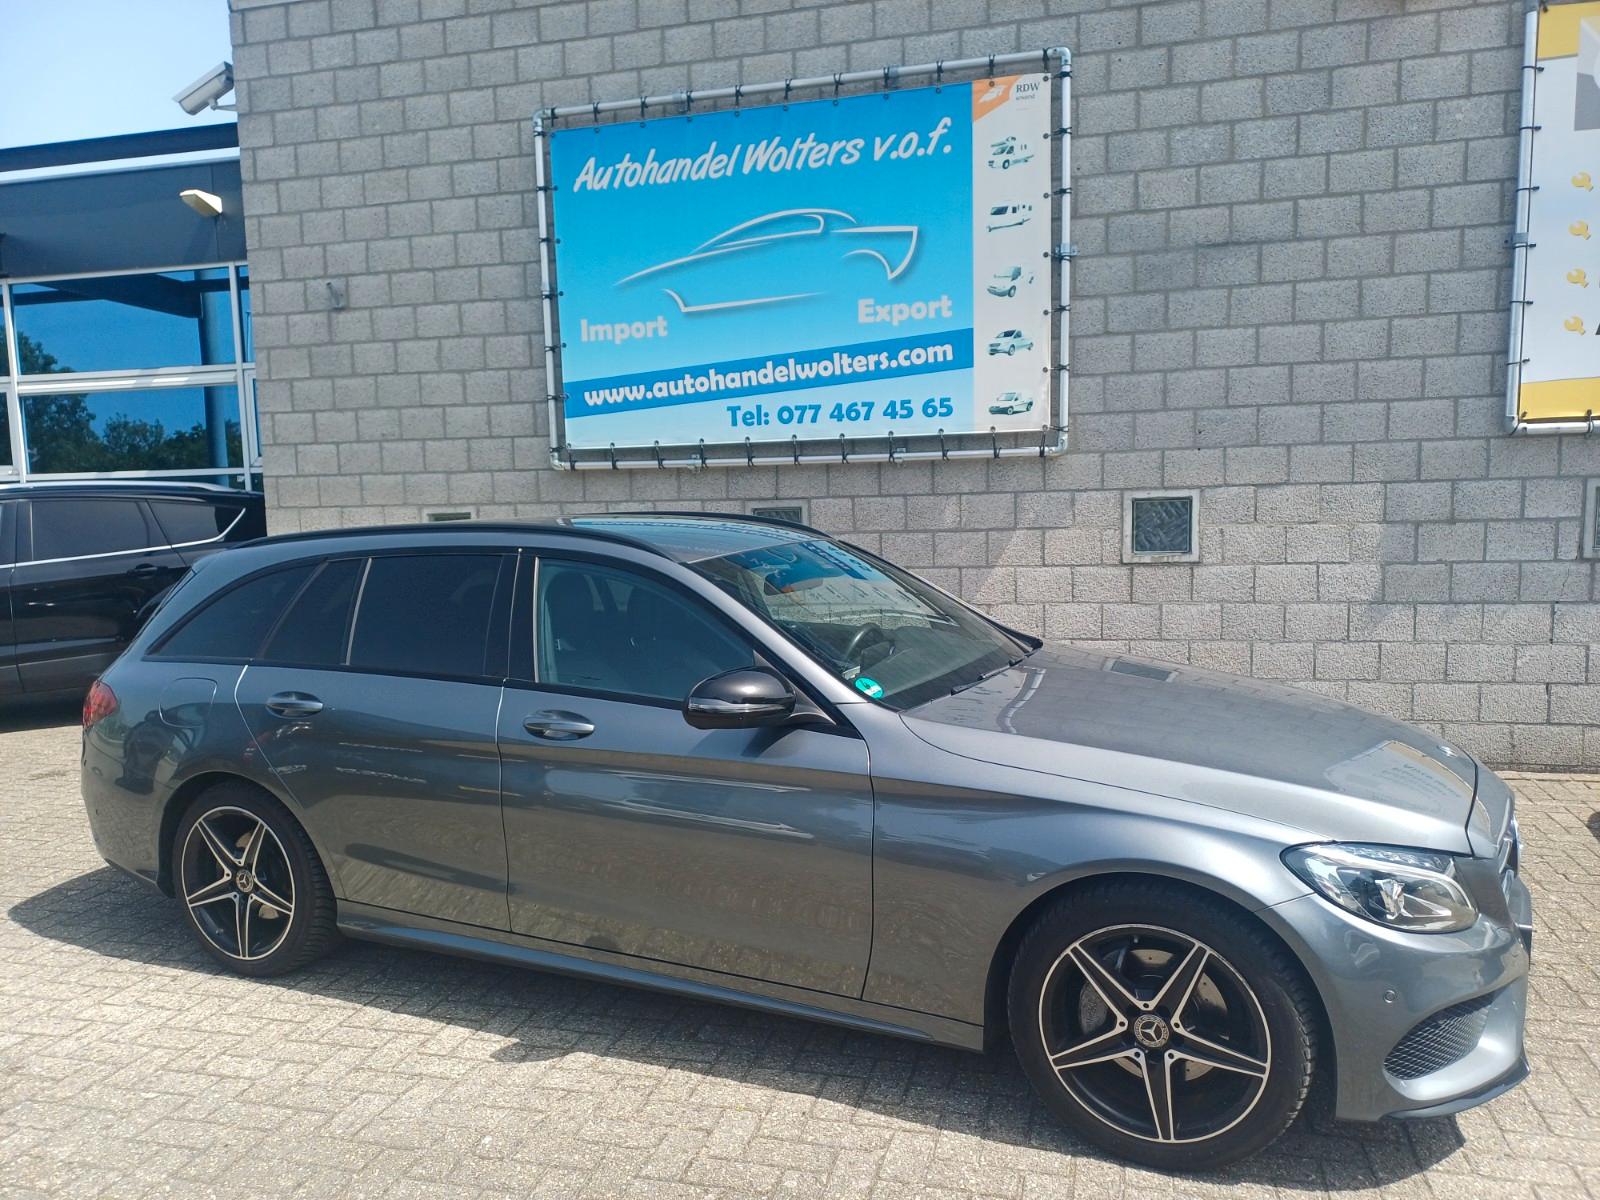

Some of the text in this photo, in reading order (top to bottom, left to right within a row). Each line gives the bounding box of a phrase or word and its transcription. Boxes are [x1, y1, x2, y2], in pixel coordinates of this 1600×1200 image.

[1016, 82, 1040, 93] RDW
[573, 116, 952, 193] Autohandel Wolters v.o.f.
[857, 294, 953, 326] Export
[580, 315, 668, 344] Import
[584, 342, 954, 407] www.autohandelwolters.com
[726, 397, 954, 427] Tel: 077 467 45 65
